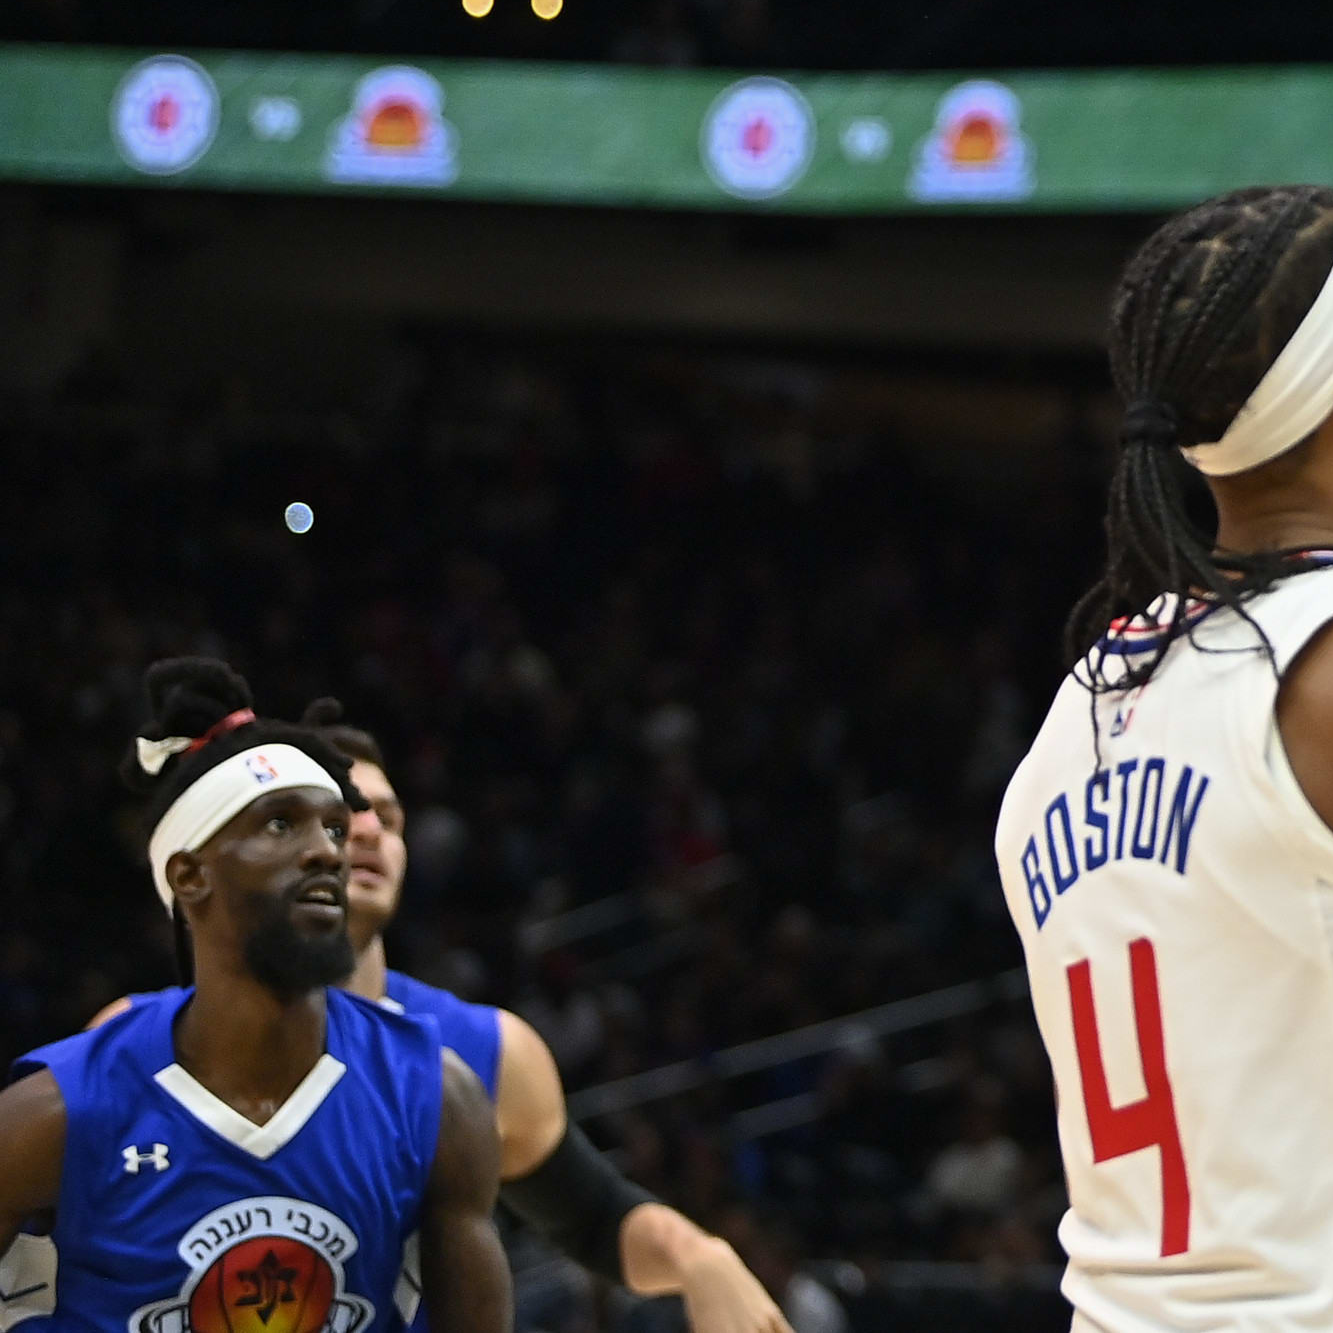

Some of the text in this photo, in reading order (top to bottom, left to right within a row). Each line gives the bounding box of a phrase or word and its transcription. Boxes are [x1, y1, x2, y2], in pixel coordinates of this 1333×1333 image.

[1021, 757, 1210, 932] BOSTON
[1066, 936, 1190, 1258] 4
[286, 1208, 348, 1257] מכבי
